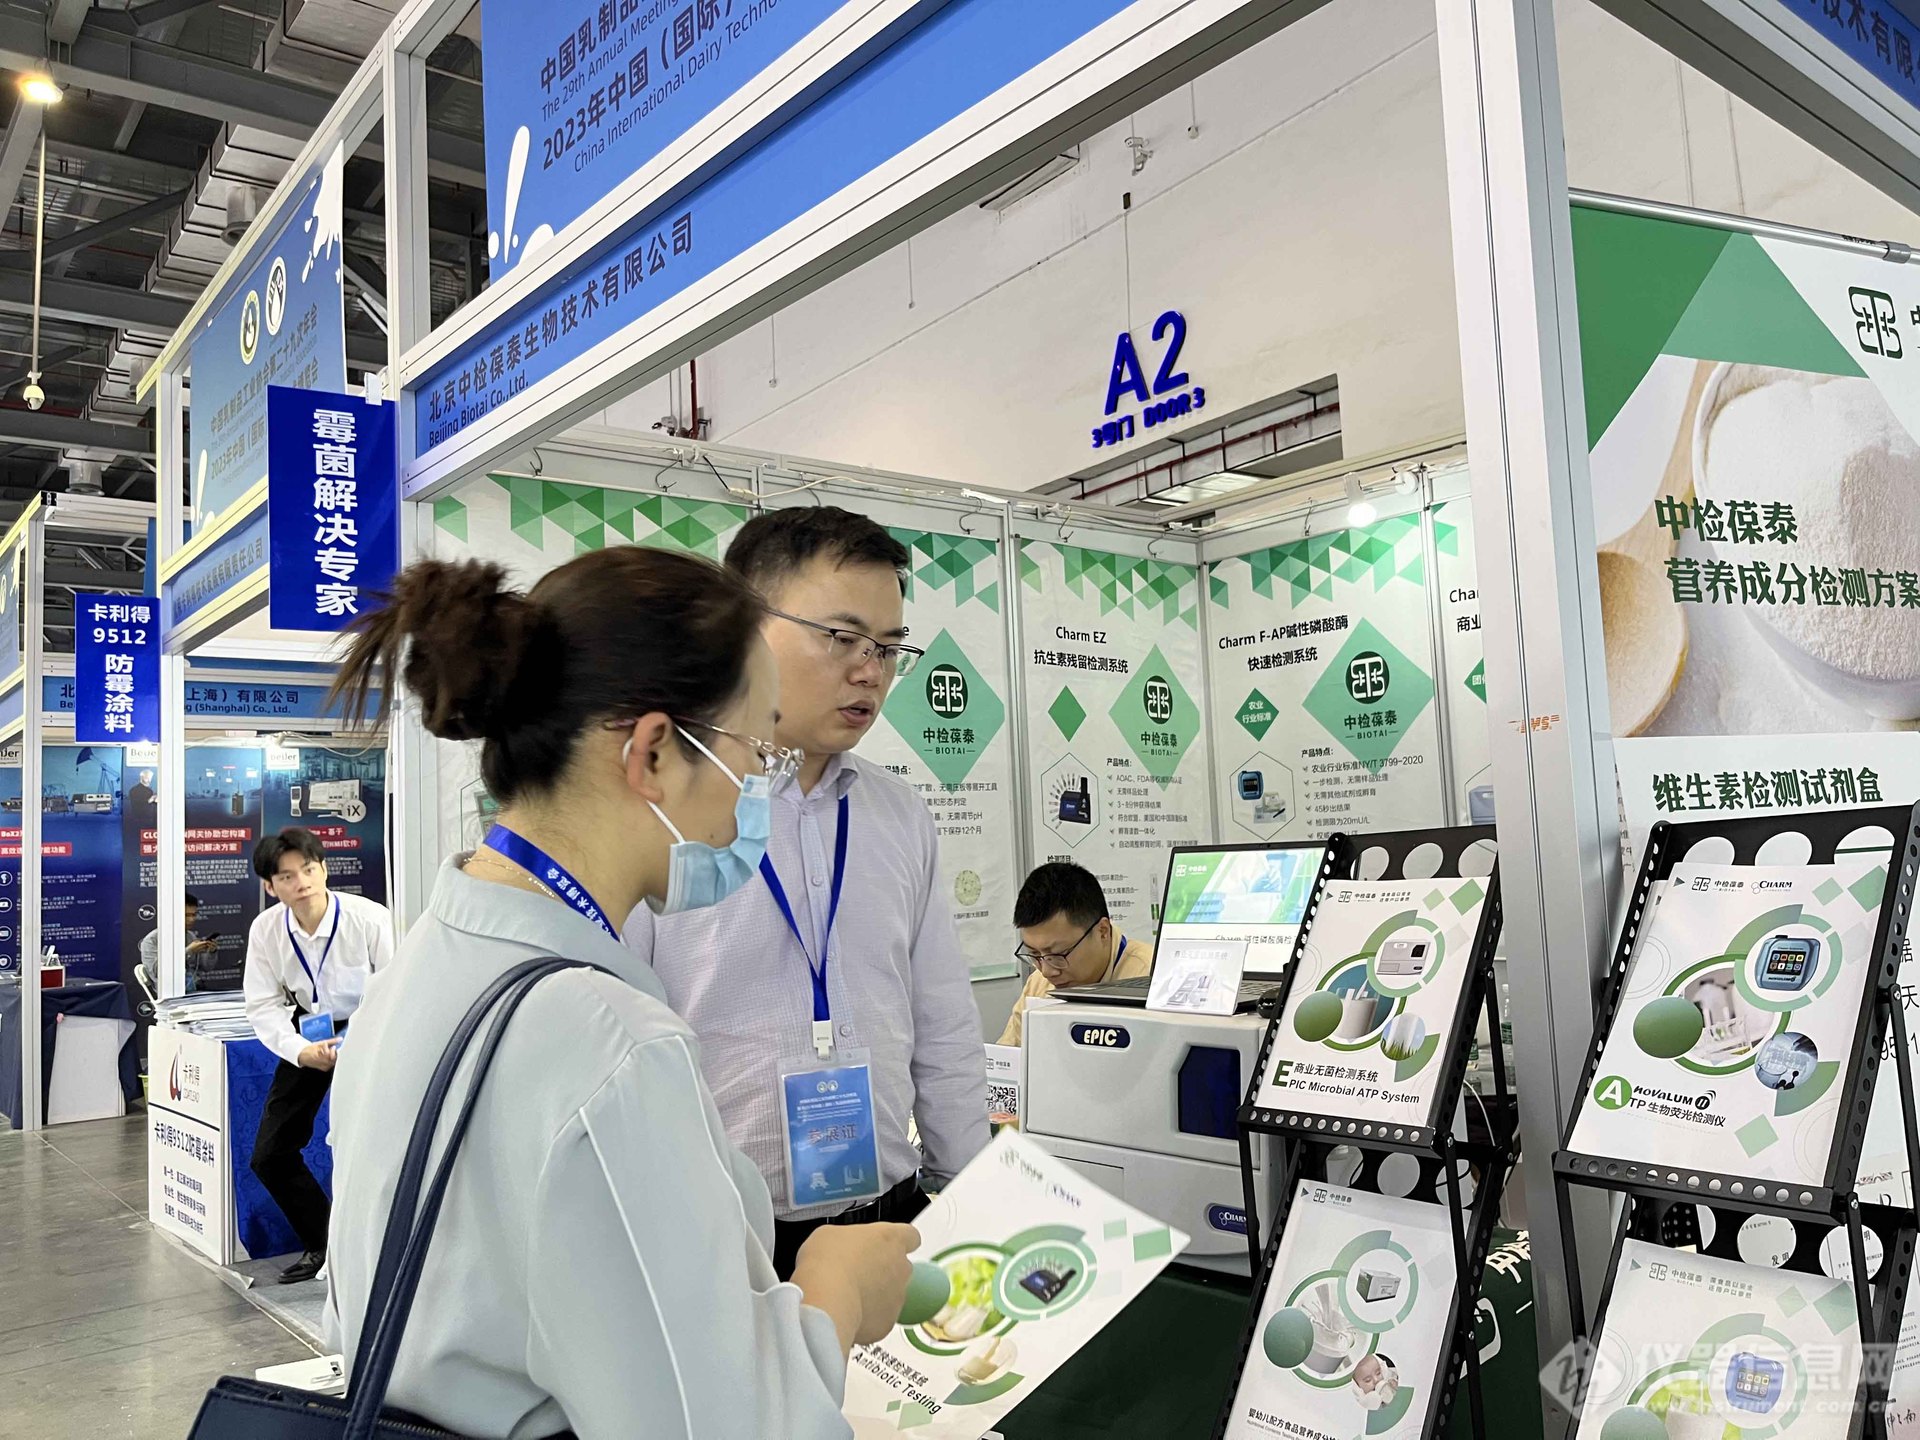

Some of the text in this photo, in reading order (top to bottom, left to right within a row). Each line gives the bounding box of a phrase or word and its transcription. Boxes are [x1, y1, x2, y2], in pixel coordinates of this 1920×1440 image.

[541, 97, 560, 122] The
[562, 73, 585, 104] 29th
[588, 38, 628, 83] Annual
[574, 137, 605, 173] China
[607, 66, 686, 146] International
[688, 36, 722, 78] Dairy
[429, 212, 693, 424] 北京中检葆泰生物技术有限公司
[1104, 310, 1189, 416] A2
[429, 415, 459, 447] Beijing
[461, 399, 488, 424] Biotai
[1143, 393, 1191, 428] DOOR
[312, 409, 359, 616] 霉菌解决专家
[1655, 495, 1798, 544] 中检葆泰
[1664, 556, 1920, 609] 营养成分检测方案
[88, 603, 151, 624] 卡利得
[93, 628, 146, 645] 9512
[1056, 626, 1107, 645] Charm EZ
[1218, 614, 1349, 651] Charm F-AP碱性磷酸酶
[1033, 649, 1129, 674] 抗生素残留检测系统
[1247, 647, 1318, 672] 快速检测系统
[104, 654, 135, 733] 防霉涂料
[195, 702, 250, 714] (Shanghai)
[253, 705, 271, 714] Co.,
[273, 705, 291, 713] Ltd.
[1344, 710, 1398, 729] 中检葆泰
[923, 728, 975, 745] 中检葆泰
[1140, 731, 1178, 749] 中检葆泰
[1357, 730, 1388, 739] BIOTAI
[935, 746, 966, 755] BIOTAI
[1380, 755, 1424, 768] 3799-2020
[1652, 767, 1884, 812] 维生素检测试剂盒
[347, 805, 361, 816] iX
[1084, 1029, 1118, 1046] EPIC
[1294, 1063, 1379, 1083] 商业无菌检测系统
[1308, 1082, 1354, 1096] Microbial
[1356, 1087, 1379, 1098] ATP
[1380, 1090, 1420, 1104] System
[1647, 1101, 1726, 1127] 生物荧光检测仪
[853, 1352, 942, 1415] Antibiotic Testing
